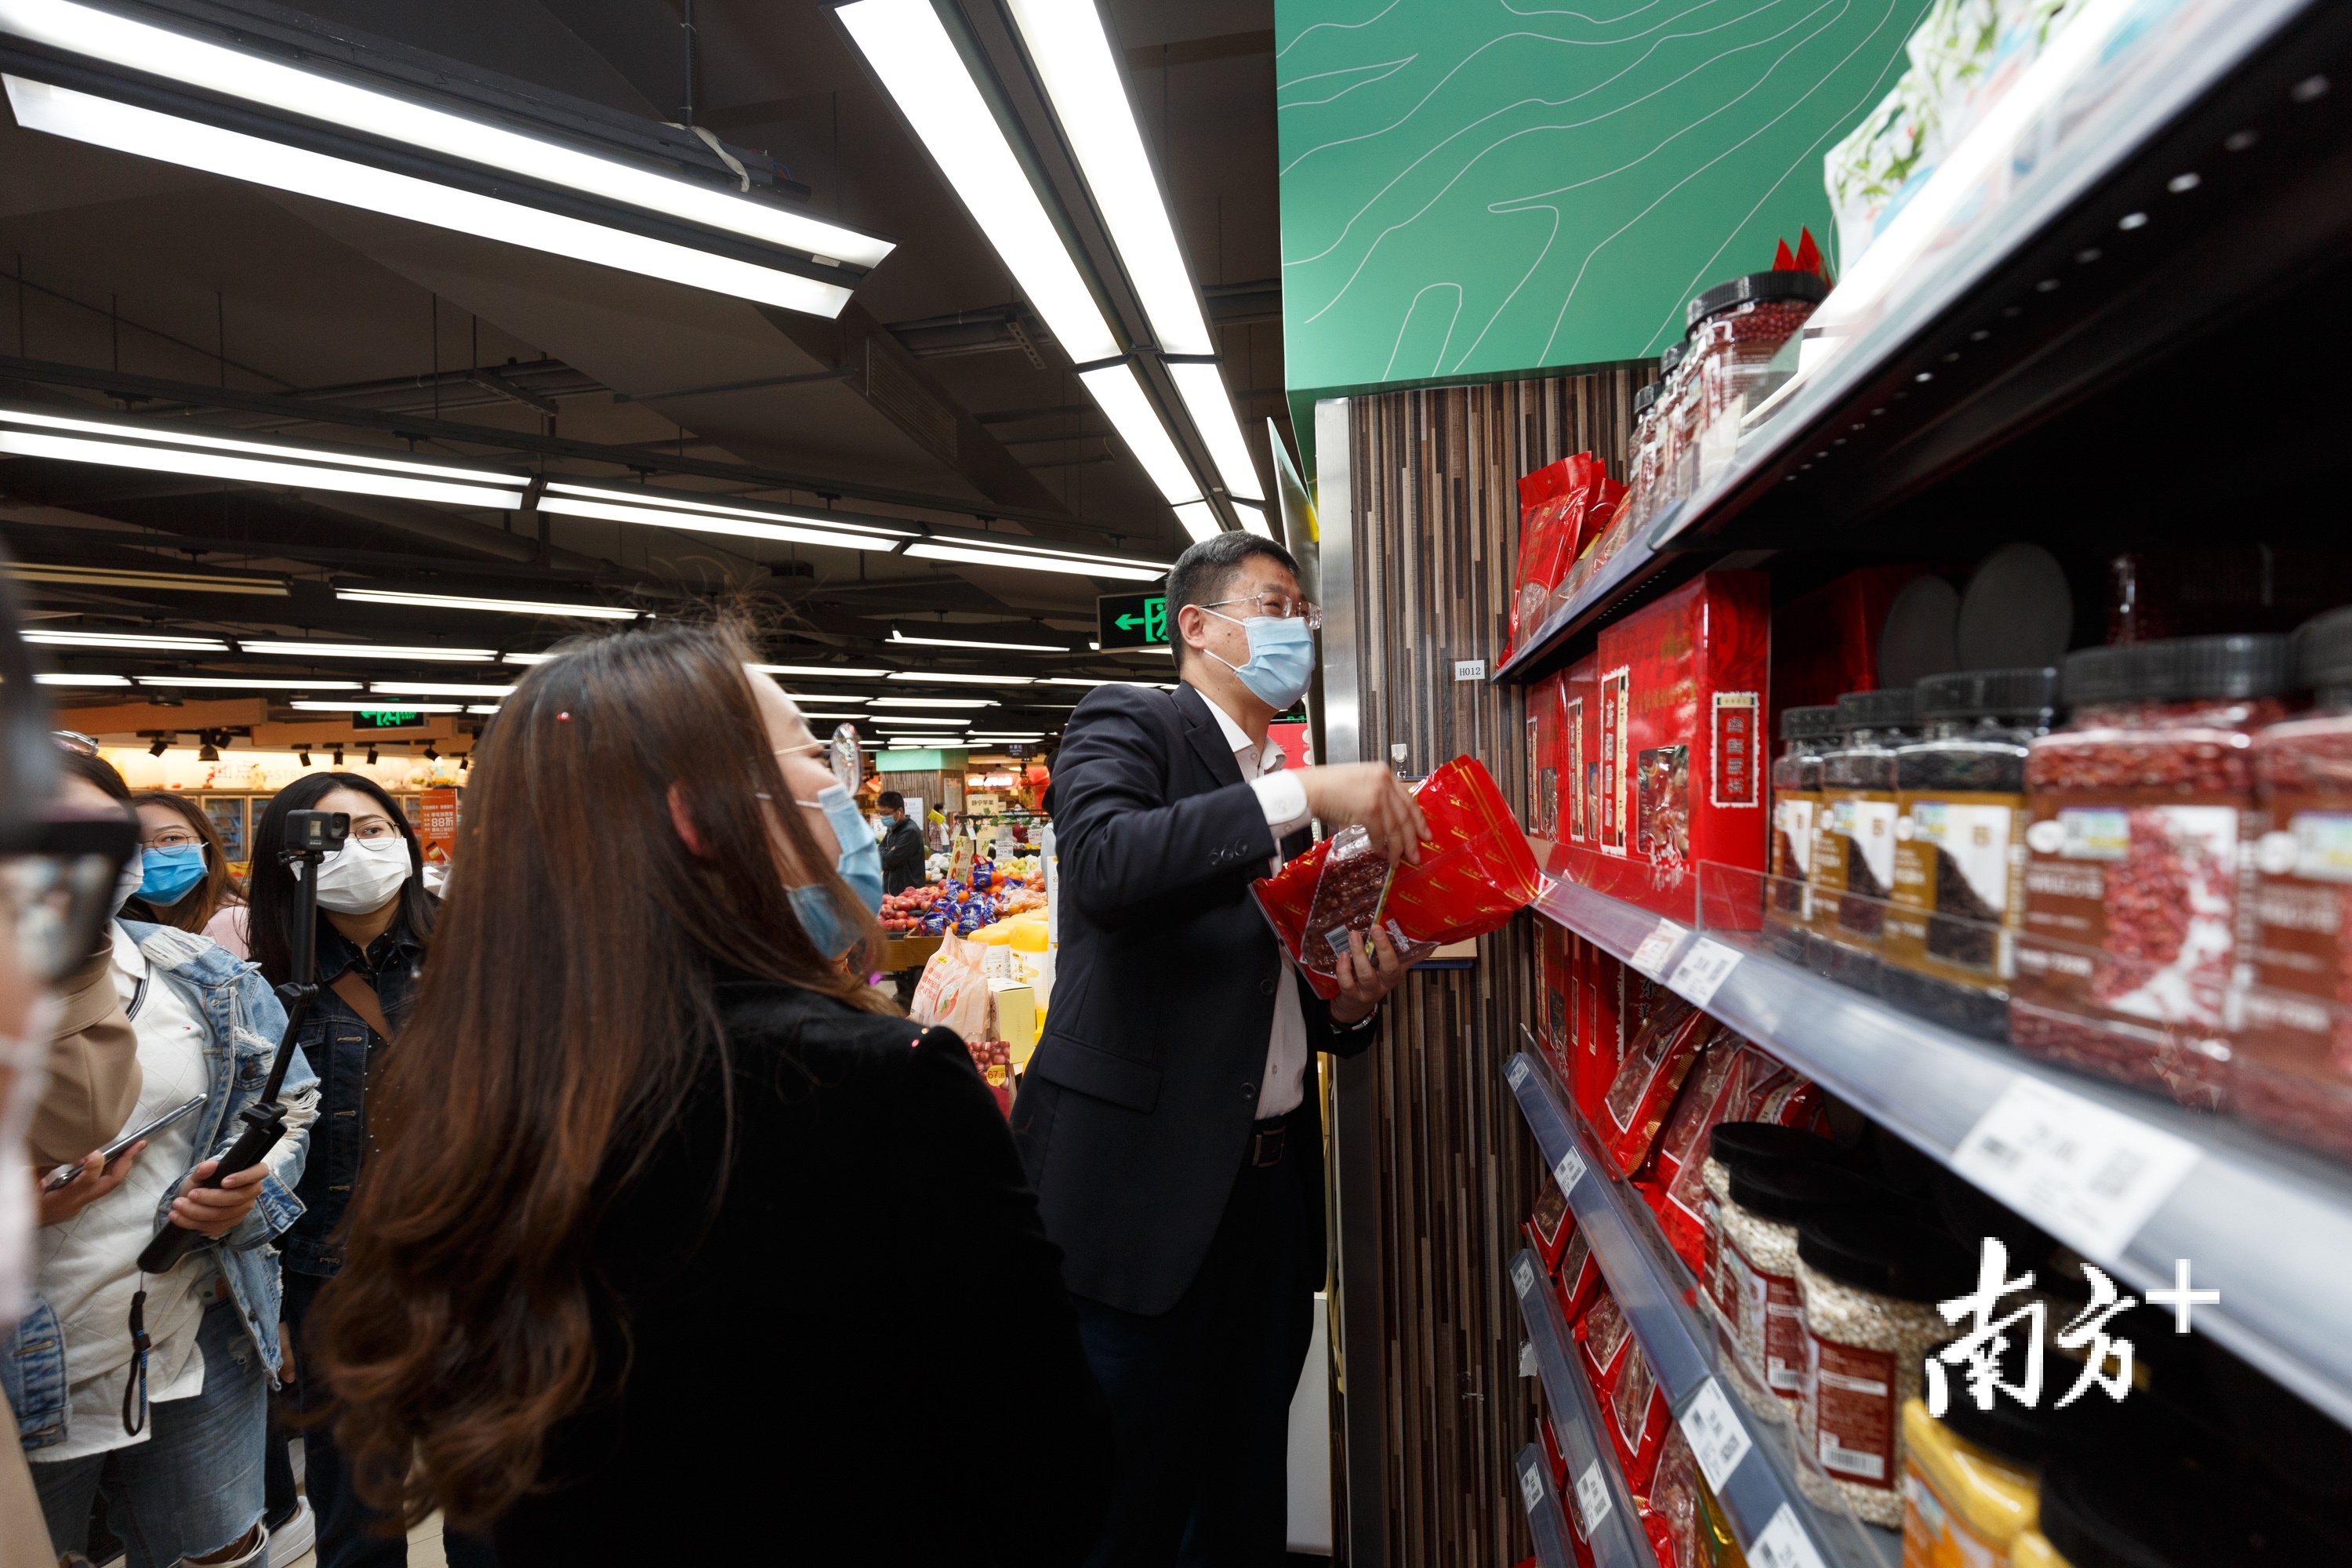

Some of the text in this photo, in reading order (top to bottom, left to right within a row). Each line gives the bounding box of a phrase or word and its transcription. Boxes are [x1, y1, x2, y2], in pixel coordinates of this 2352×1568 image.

[1459, 666, 1481, 676] H012
[1726, 717, 1744, 793] 东翔腊肠
[431, 817, 453, 827] 88折
[987, 1070, 1005, 1080] 67.6
